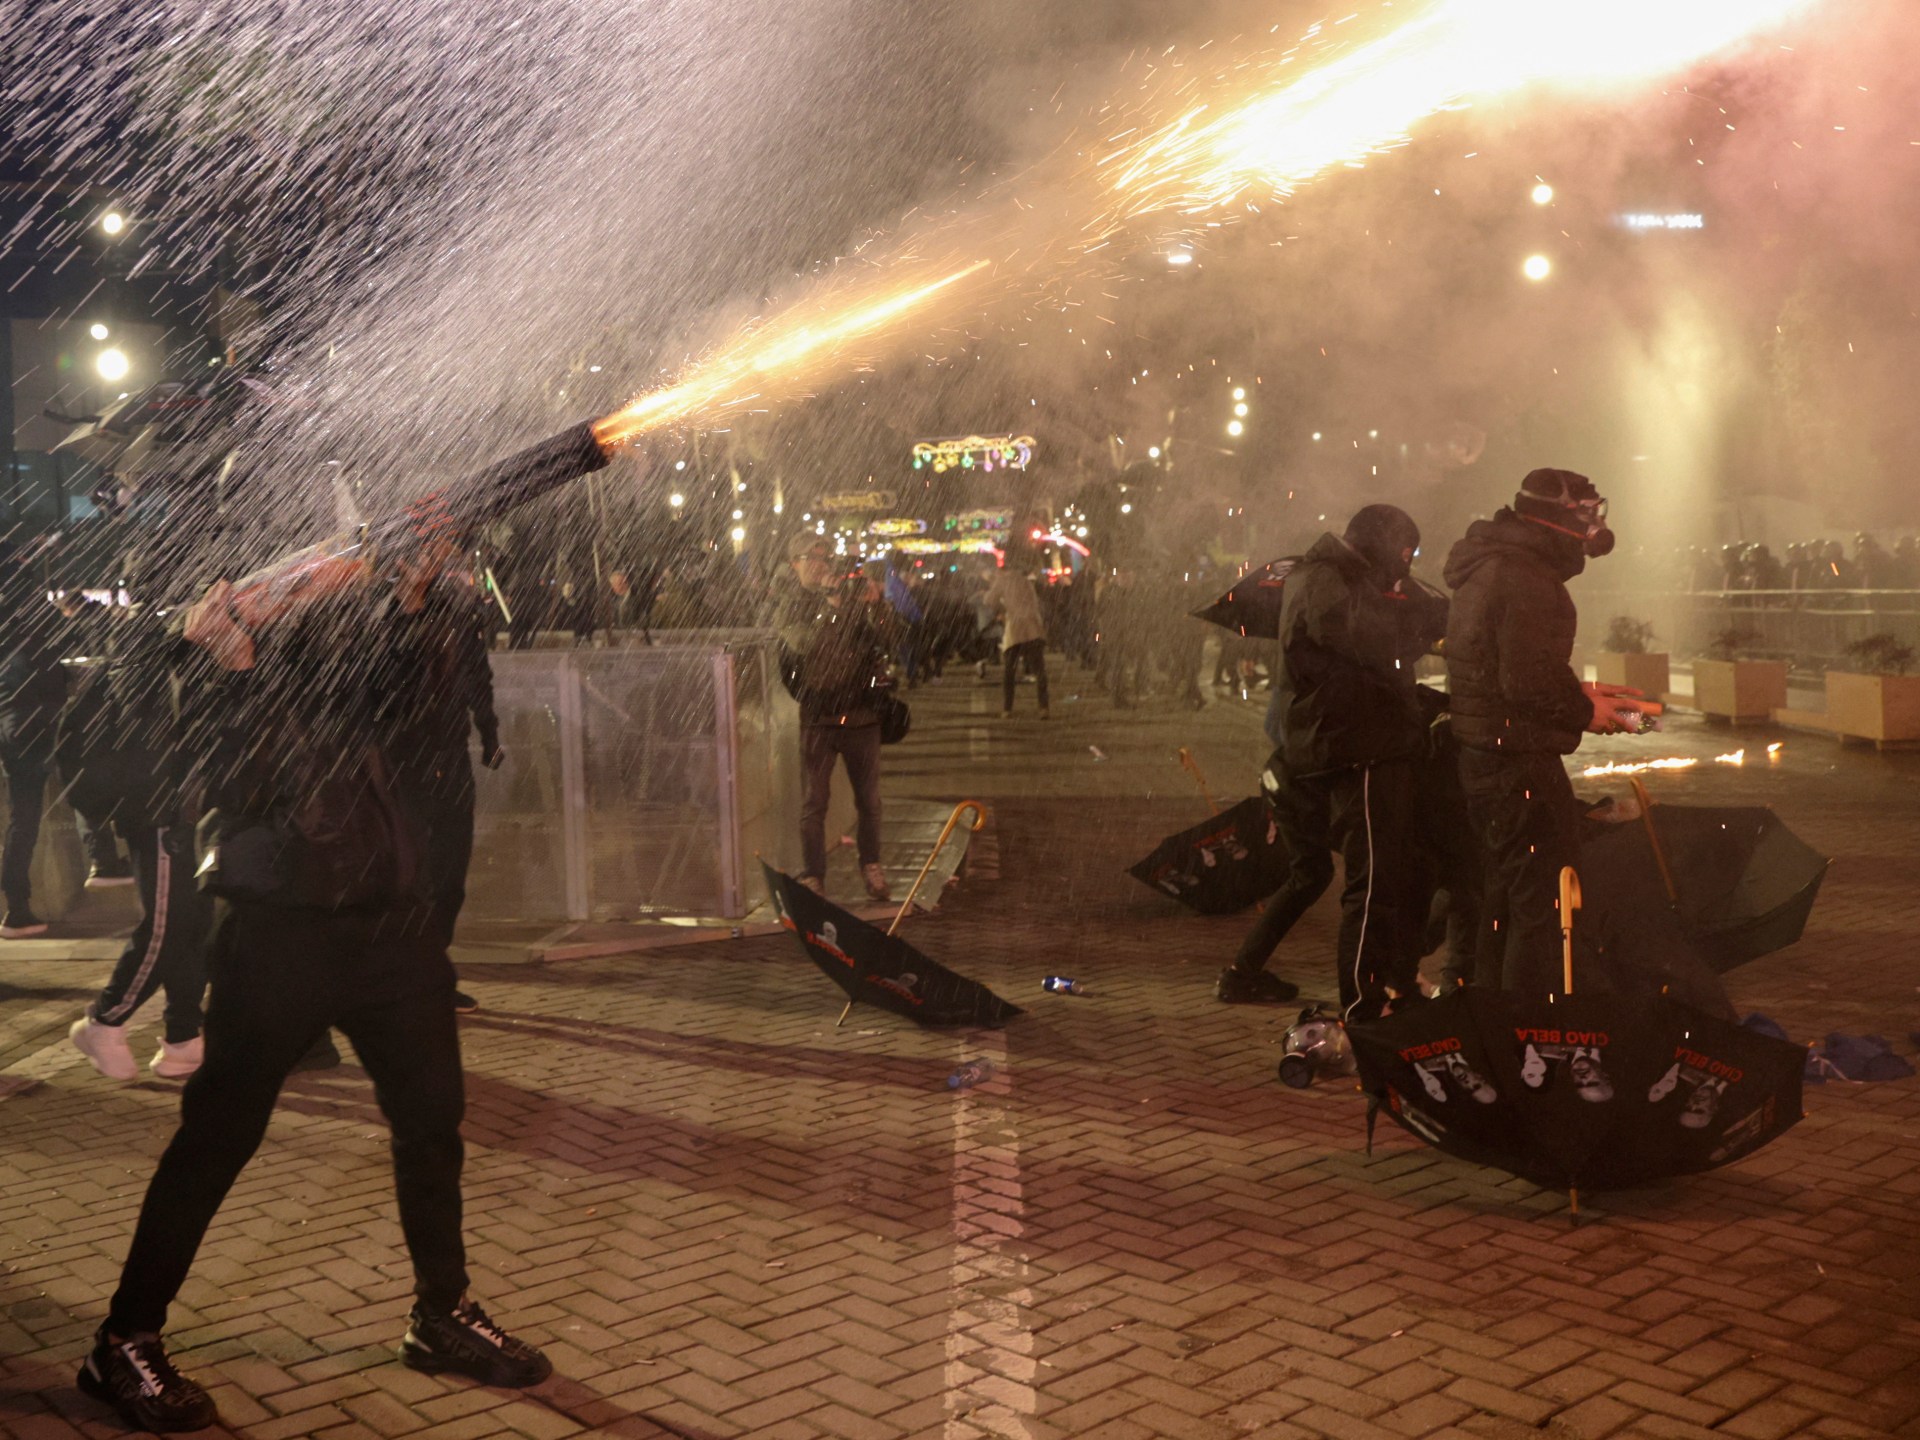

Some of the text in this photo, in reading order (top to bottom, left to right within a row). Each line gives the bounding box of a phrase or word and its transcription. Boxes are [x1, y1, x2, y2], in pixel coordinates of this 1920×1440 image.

[1398, 1037, 1462, 1062] CIAO BELA
[1515, 1028, 1609, 1047] CIAO BELA
[1674, 1046, 1744, 1083] CIAO BELA
